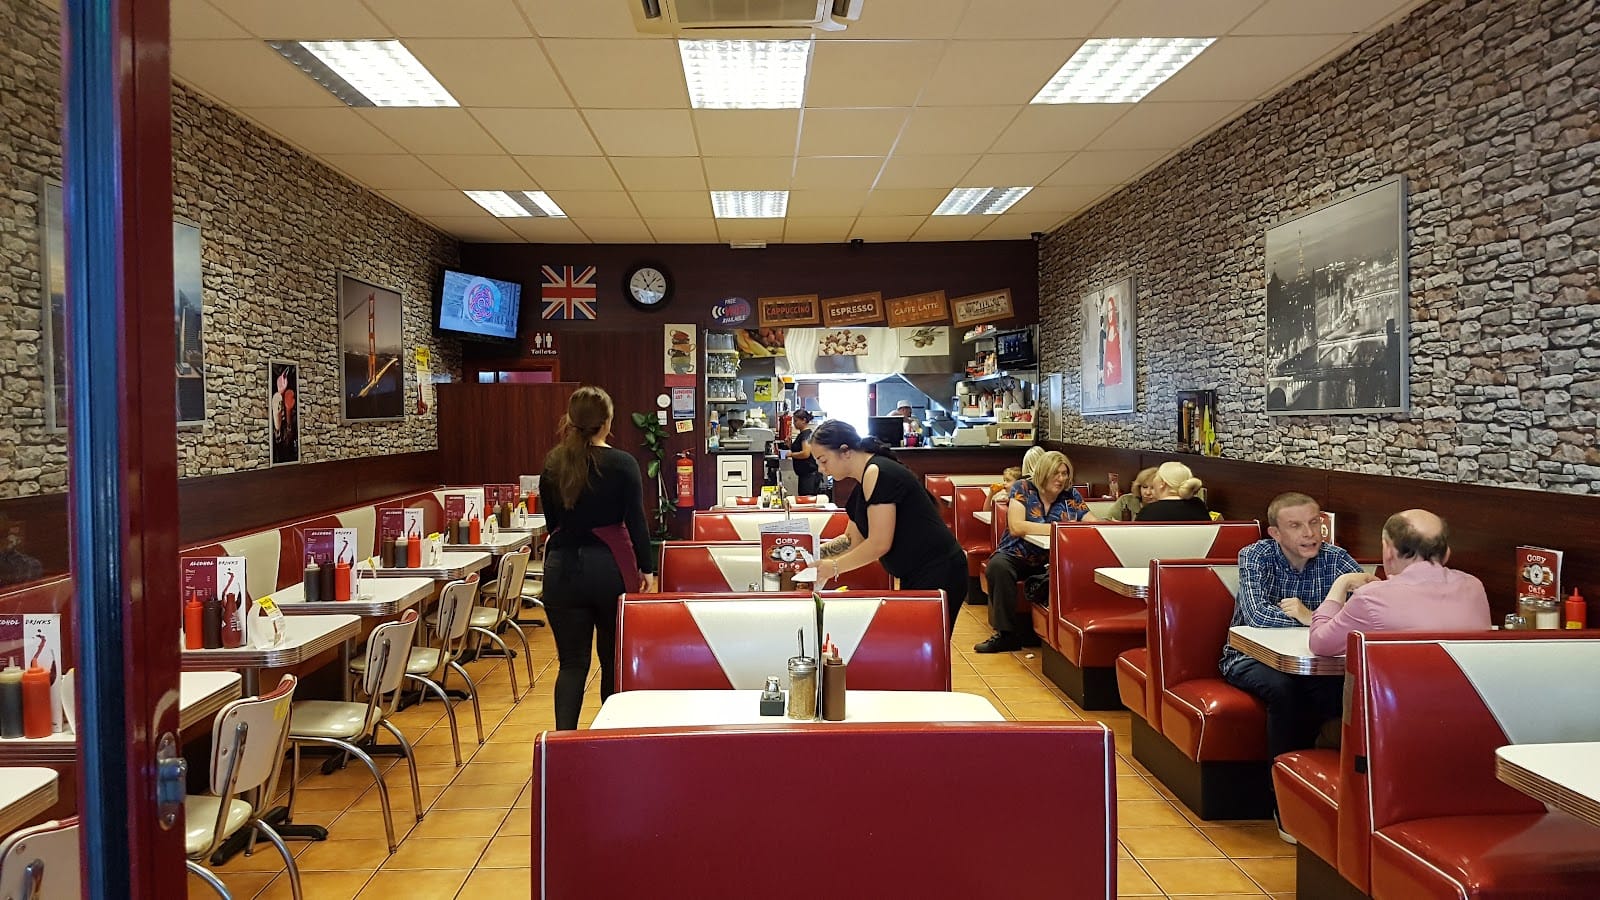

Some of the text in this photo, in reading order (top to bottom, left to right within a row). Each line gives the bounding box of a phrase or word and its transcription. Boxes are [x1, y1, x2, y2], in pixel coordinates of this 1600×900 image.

[766, 305, 810, 316] CAPPUCCINO
[830, 303, 874, 317] ESPRESSO
[918, 302, 939, 312] LATTE
